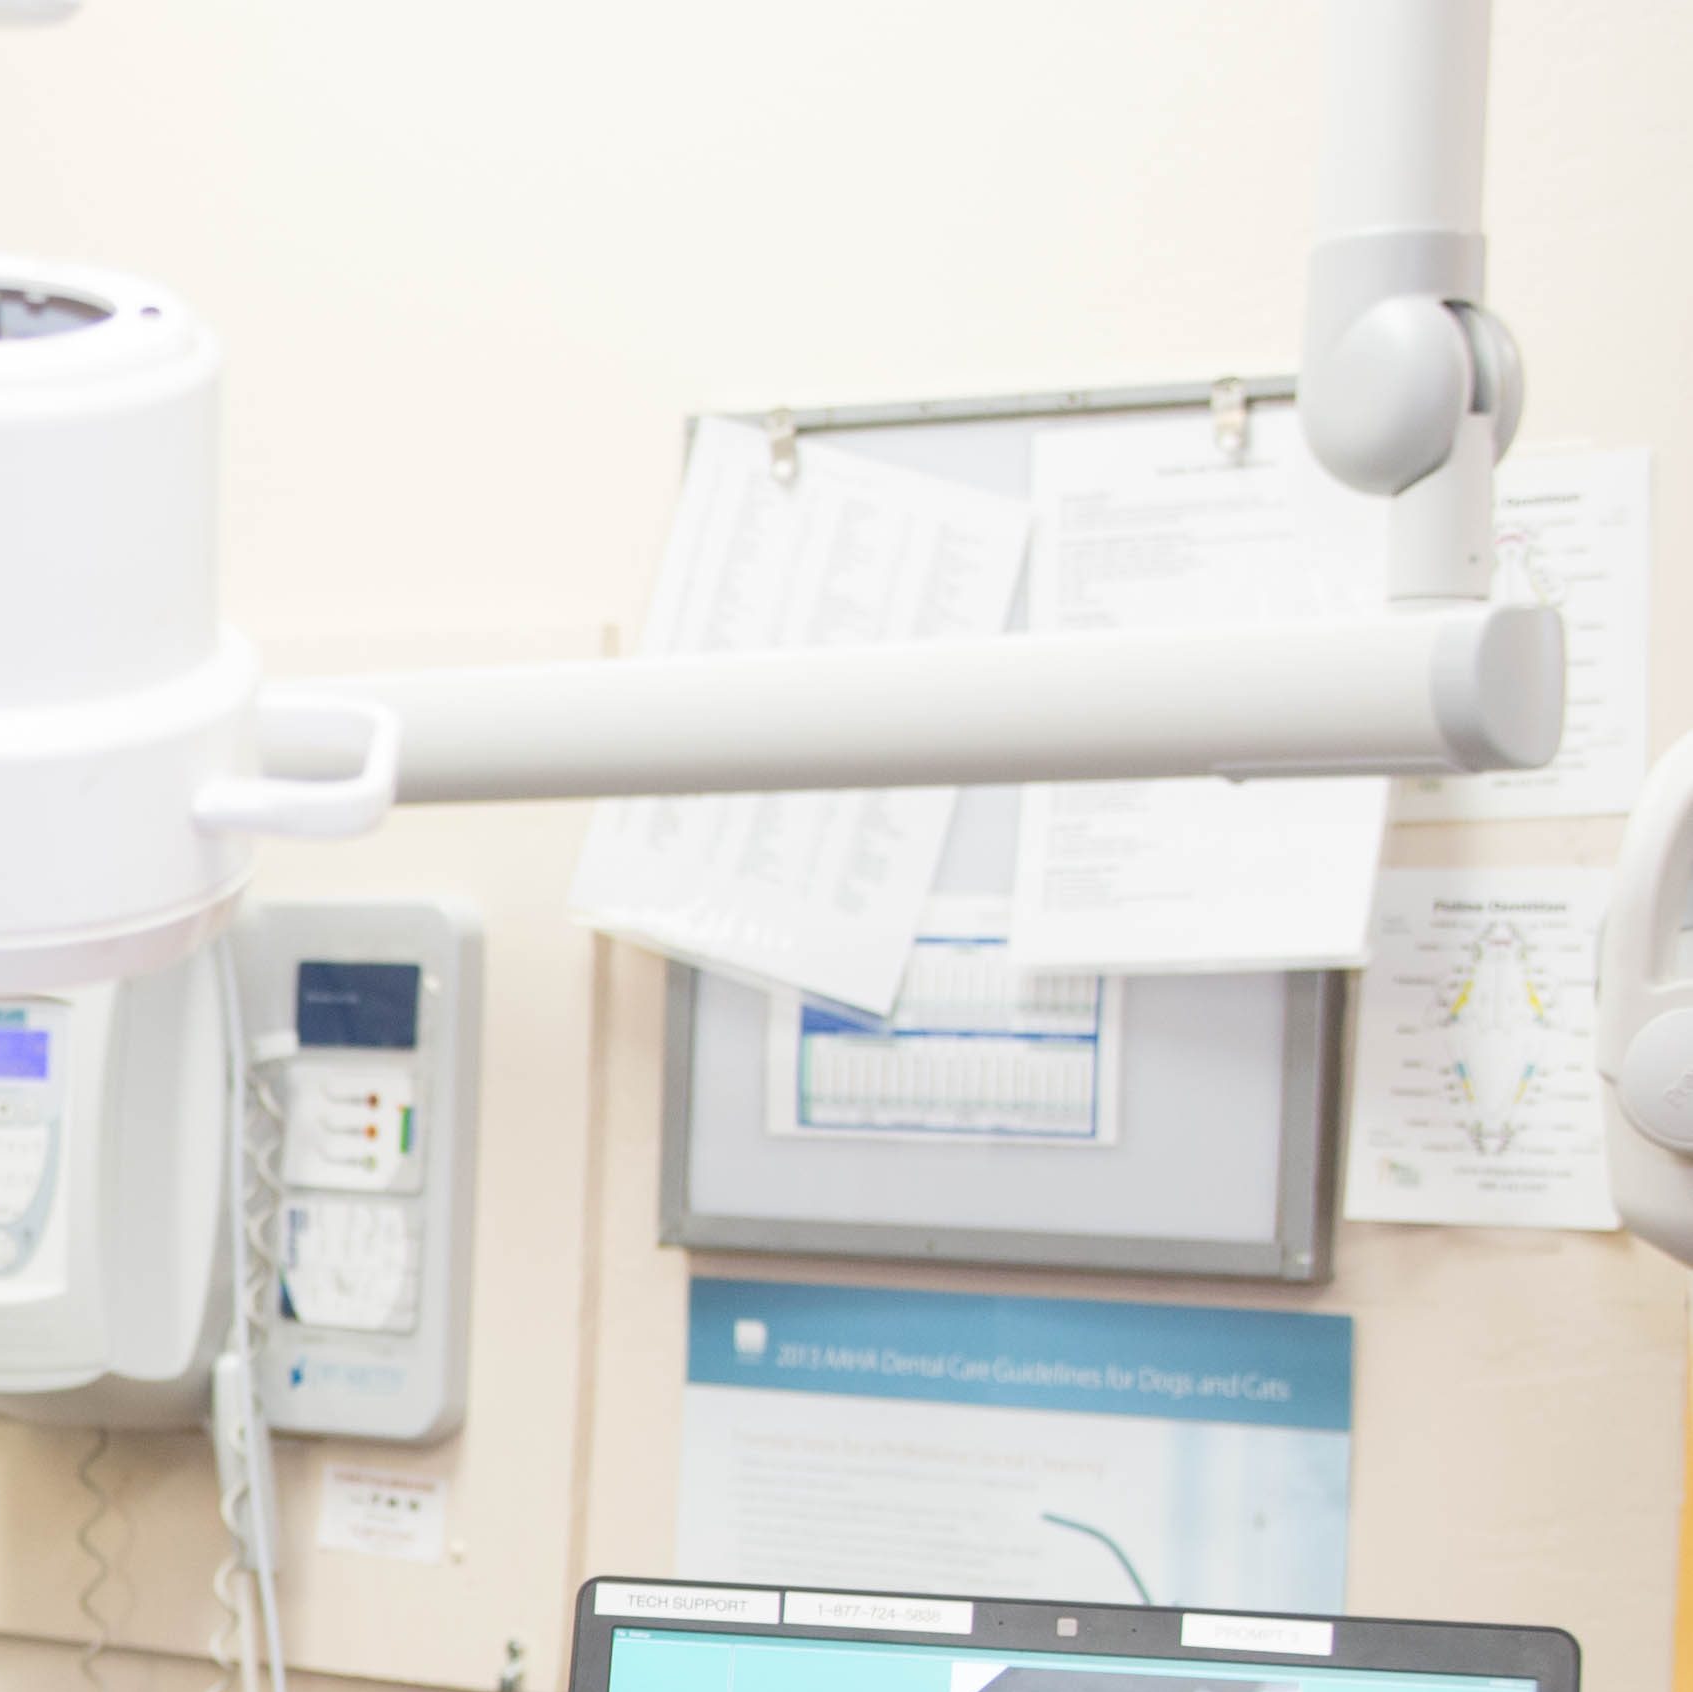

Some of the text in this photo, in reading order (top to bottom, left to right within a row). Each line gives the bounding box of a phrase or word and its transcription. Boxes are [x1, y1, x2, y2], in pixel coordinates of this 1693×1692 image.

[882, 1353, 947, 1379] Dental
[950, 1358, 991, 1382] Care
[993, 1360, 1104, 1389] Guidelines
[1106, 1366, 1136, 1391] for
[1140, 1369, 1192, 1399] Dogs
[1196, 1373, 1238, 1399] and
[1241, 1376, 1291, 1402] Cats
[627, 1593, 749, 1615] TECH SUPPORT
